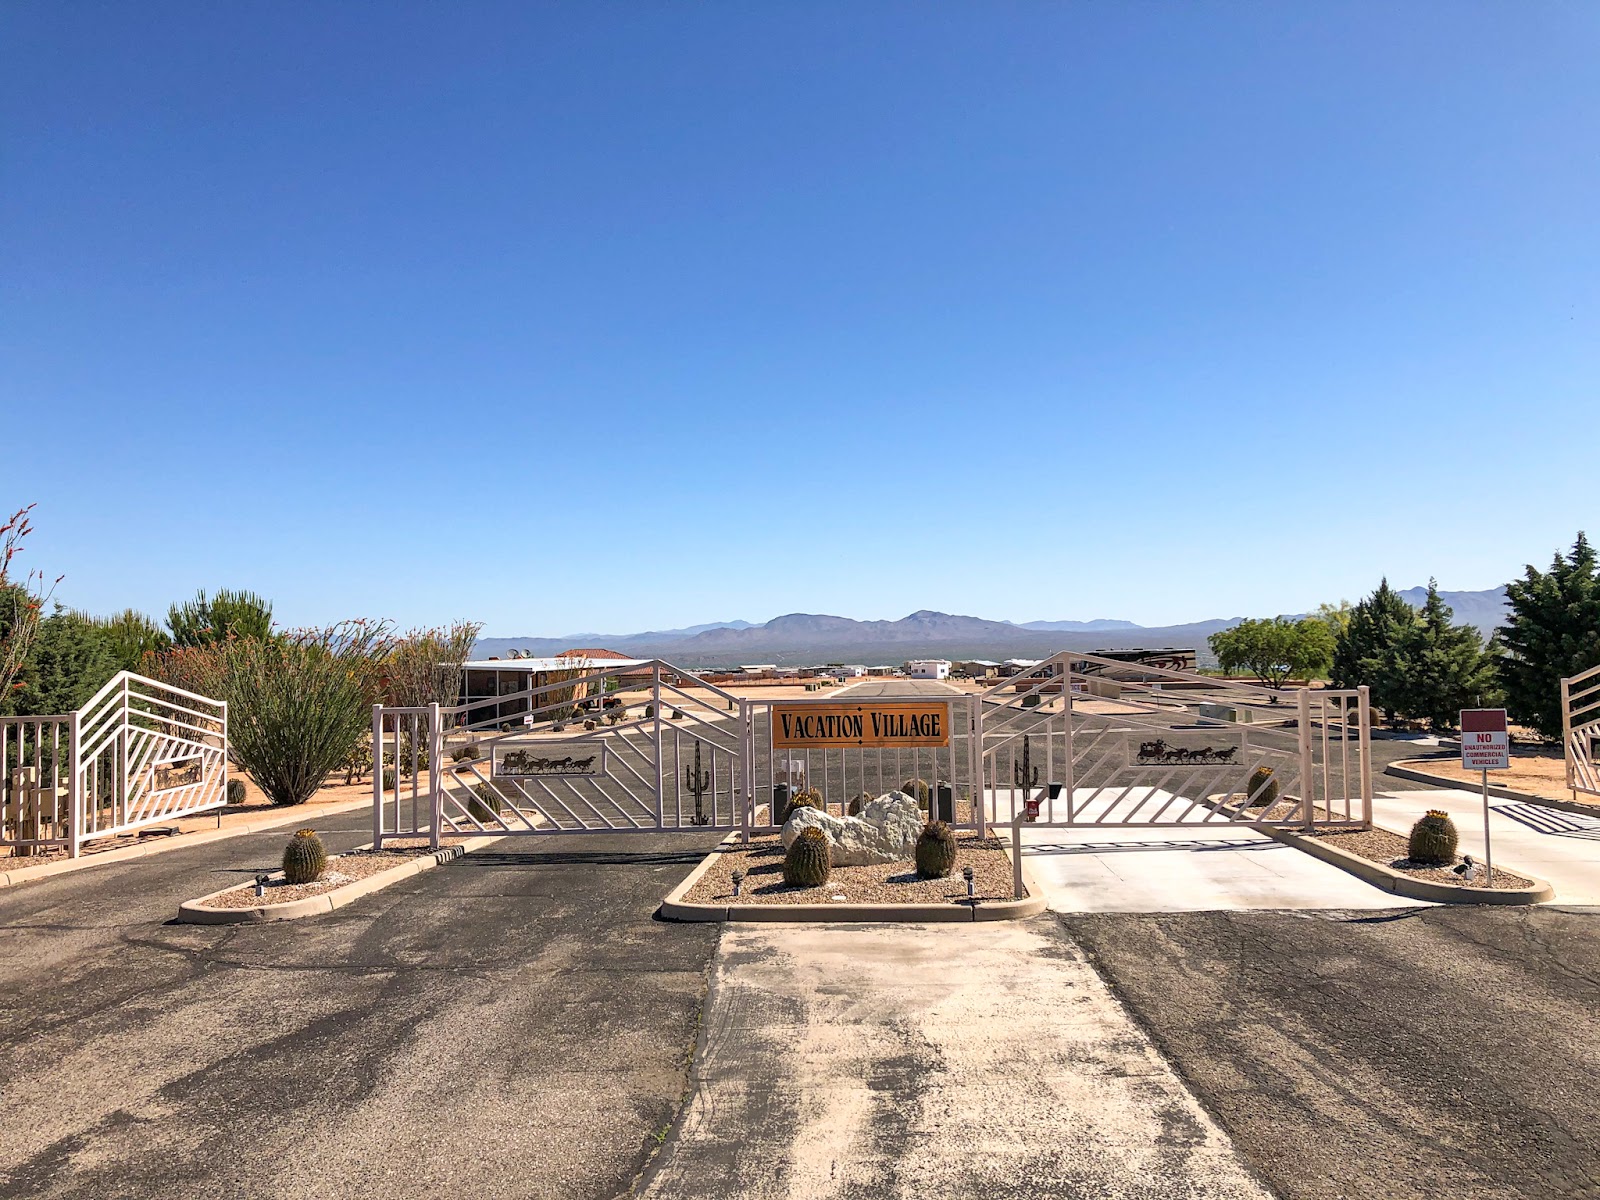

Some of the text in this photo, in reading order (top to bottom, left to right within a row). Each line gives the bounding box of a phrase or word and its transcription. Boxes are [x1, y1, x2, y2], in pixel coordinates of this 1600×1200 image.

[781, 712, 941, 738] VACATION VILLAGE
[1477, 734, 1492, 742] NO
